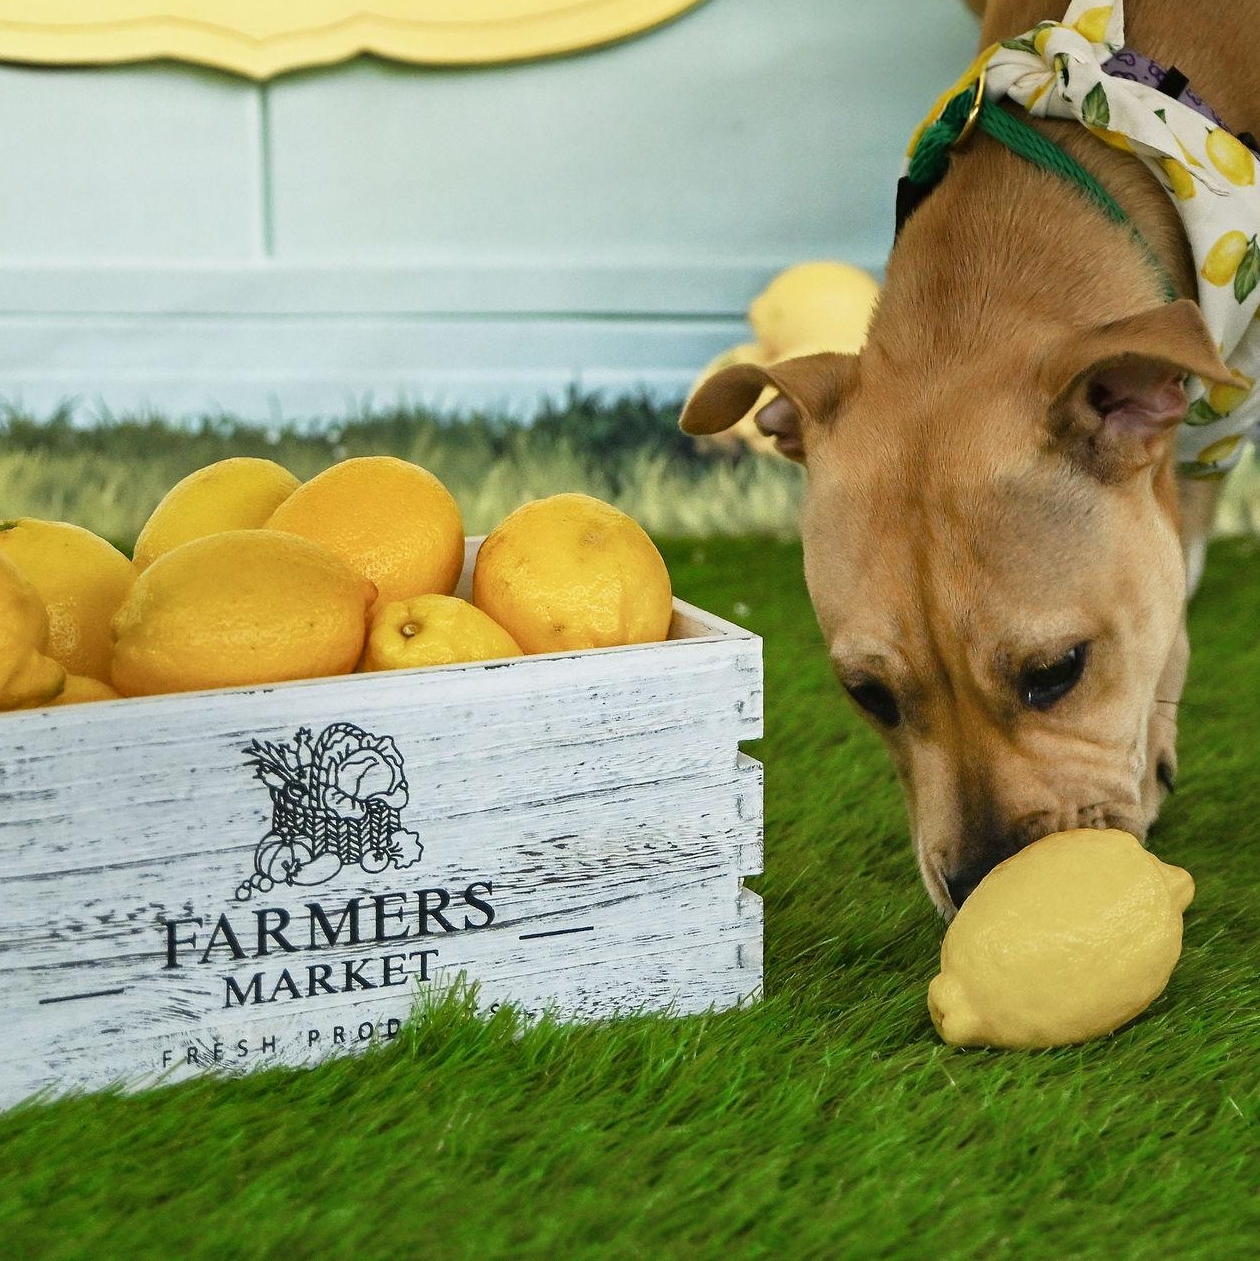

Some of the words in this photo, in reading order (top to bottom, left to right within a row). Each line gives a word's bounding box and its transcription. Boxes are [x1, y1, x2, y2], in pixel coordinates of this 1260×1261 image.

[163, 881, 496, 969] FARMERS
[221, 949, 440, 1008] MARKET
[162, 1035, 276, 1068] FRESH
